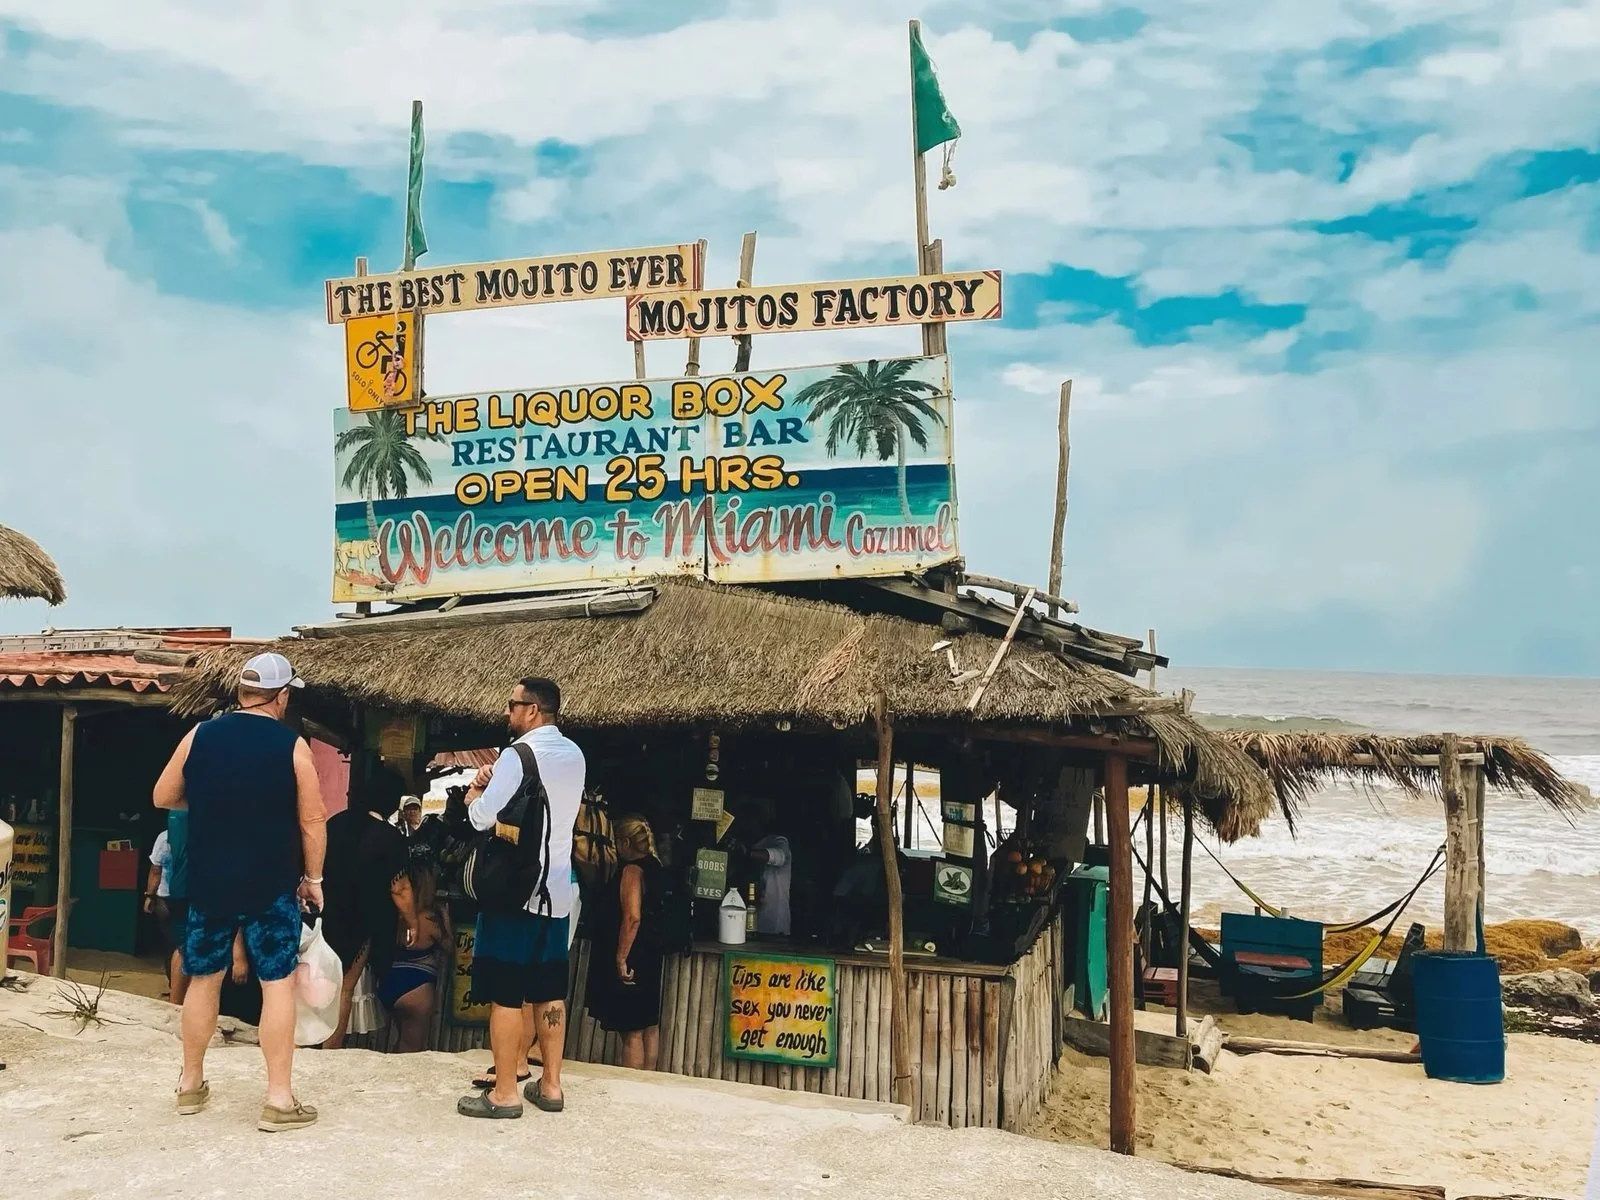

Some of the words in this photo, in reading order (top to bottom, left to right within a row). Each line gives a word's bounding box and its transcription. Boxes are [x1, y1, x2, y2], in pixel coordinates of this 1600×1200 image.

[335, 282, 393, 315] THE
[400, 273, 466, 310] BEST
[476, 260, 599, 303] MOJITO
[608, 253, 687, 290] EVER
[637, 291, 799, 336] MOJITOS
[812, 278, 984, 327] FACTORY
[351, 371, 366, 388] SOLO
[368, 389, 384, 405] ONLY
[398, 397, 480, 436] THE
[487, 384, 654, 429] LIQUOR
[671, 374, 787, 421] BOX
[451, 424, 700, 467] RESTAURANT
[723, 417, 809, 448] BAR
[455, 464, 588, 505] OPEN
[606, 454, 667, 502] 25
[680, 454, 800, 494] HRS.
[376, 510, 600, 586] Welcome
[605, 508, 652, 562] to
[653, 492, 842, 565] Miami
[845, 502, 953, 558] Cozumel
[697, 887, 722, 898] EYES
[456, 932, 474, 953] Tip
[732, 965, 762, 990] Tips
[768, 973, 791, 988] are
[795, 969, 826, 992] like
[731, 999, 760, 1016] sex
[764, 1002, 791, 1023] you
[794, 1003, 832, 1021] never
[736, 1026, 768, 1050] get
[776, 1029, 827, 1058] enough
